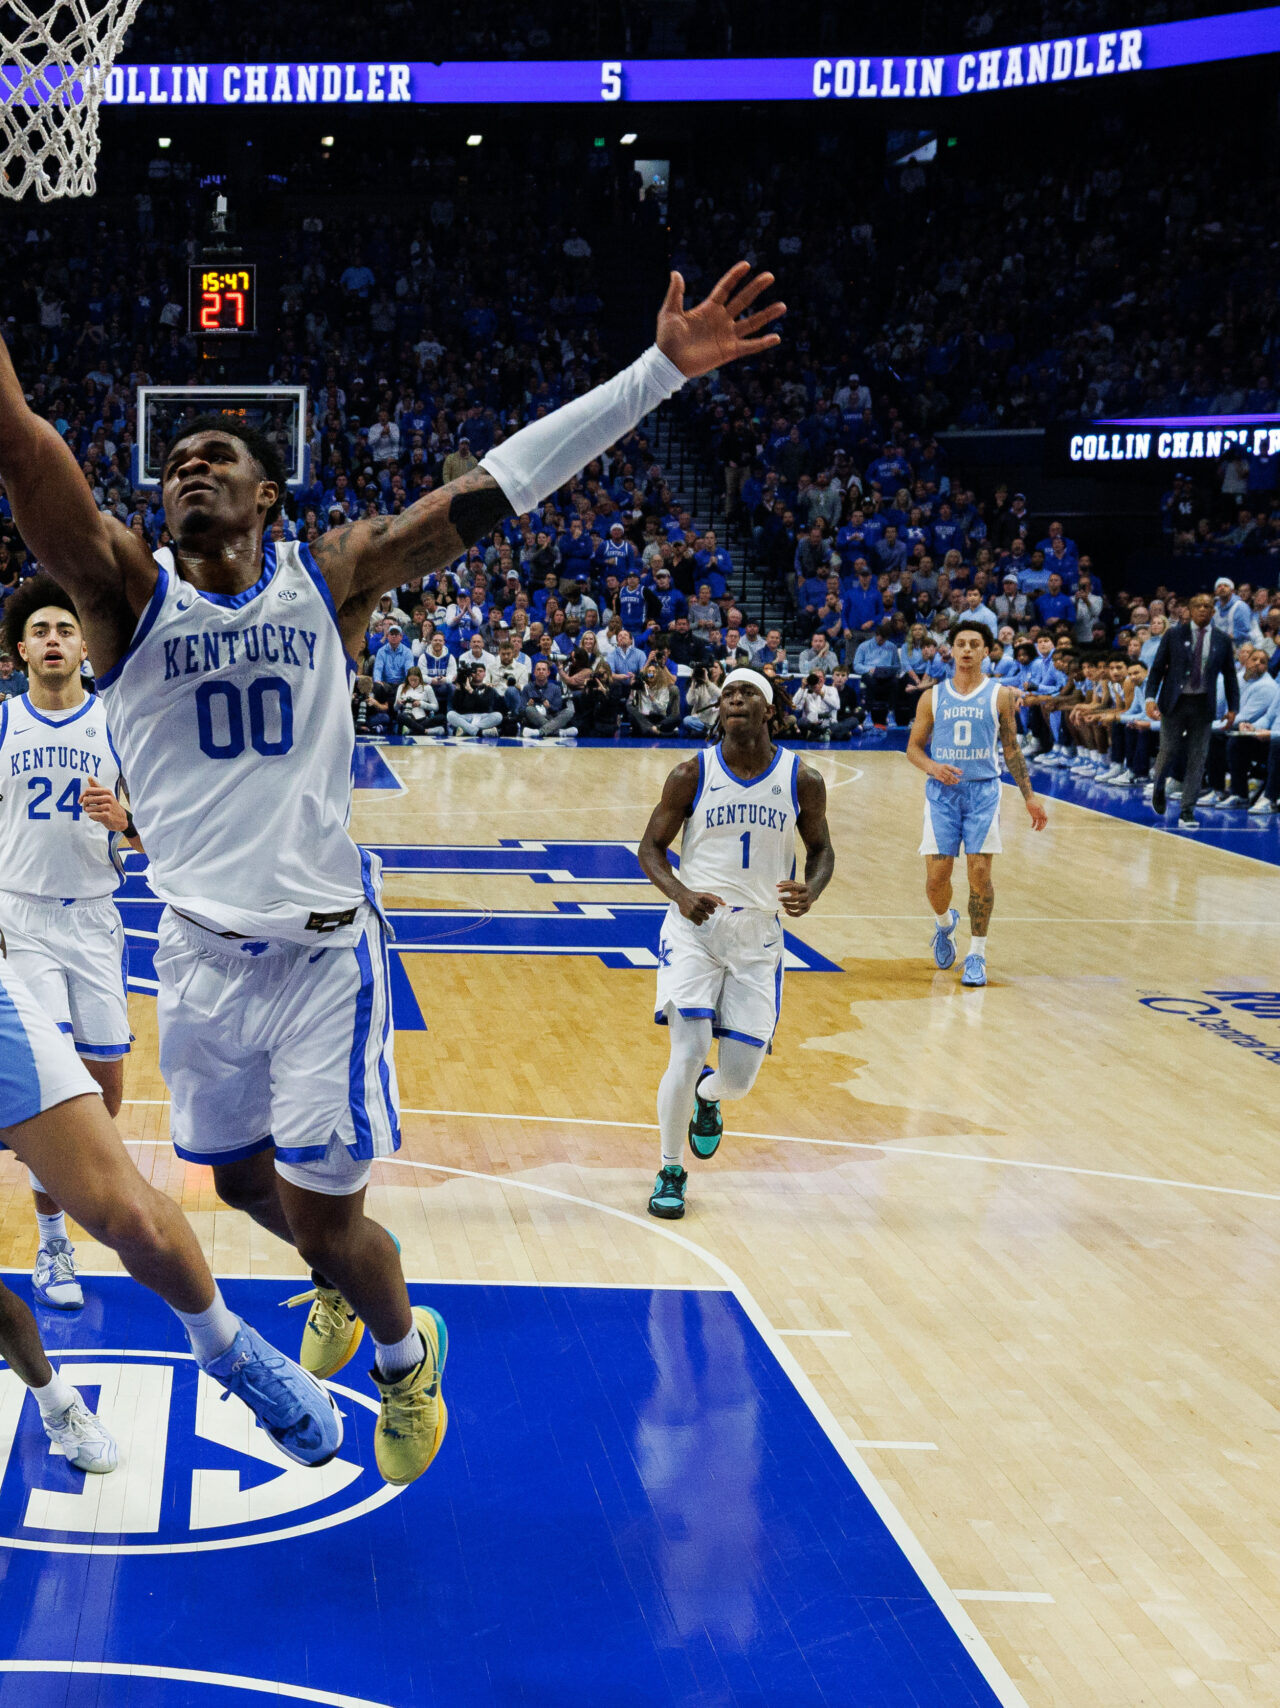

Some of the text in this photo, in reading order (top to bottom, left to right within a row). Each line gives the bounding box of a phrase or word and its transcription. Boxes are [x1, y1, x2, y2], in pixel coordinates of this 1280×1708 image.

[601, 63, 622, 100] 5
[813, 29, 1144, 99] COLLIN CHANDLER
[223, 64, 412, 103] CHANDLER
[202, 271, 249, 292] 15:47
[200, 292, 245, 328] 27
[1070, 433, 1152, 462] COLLIN
[163, 624, 317, 682] KENTUCKY
[194, 676, 295, 760] 00
[943, 705, 984, 720] NORTH
[953, 720, 972, 746] 0
[10, 745, 102, 778] KENTUCKY
[935, 747, 991, 761] CAROLINA
[27, 776, 84, 821] 24
[705, 803, 787, 832] KENTUCKY
[739, 831, 751, 869] 1
